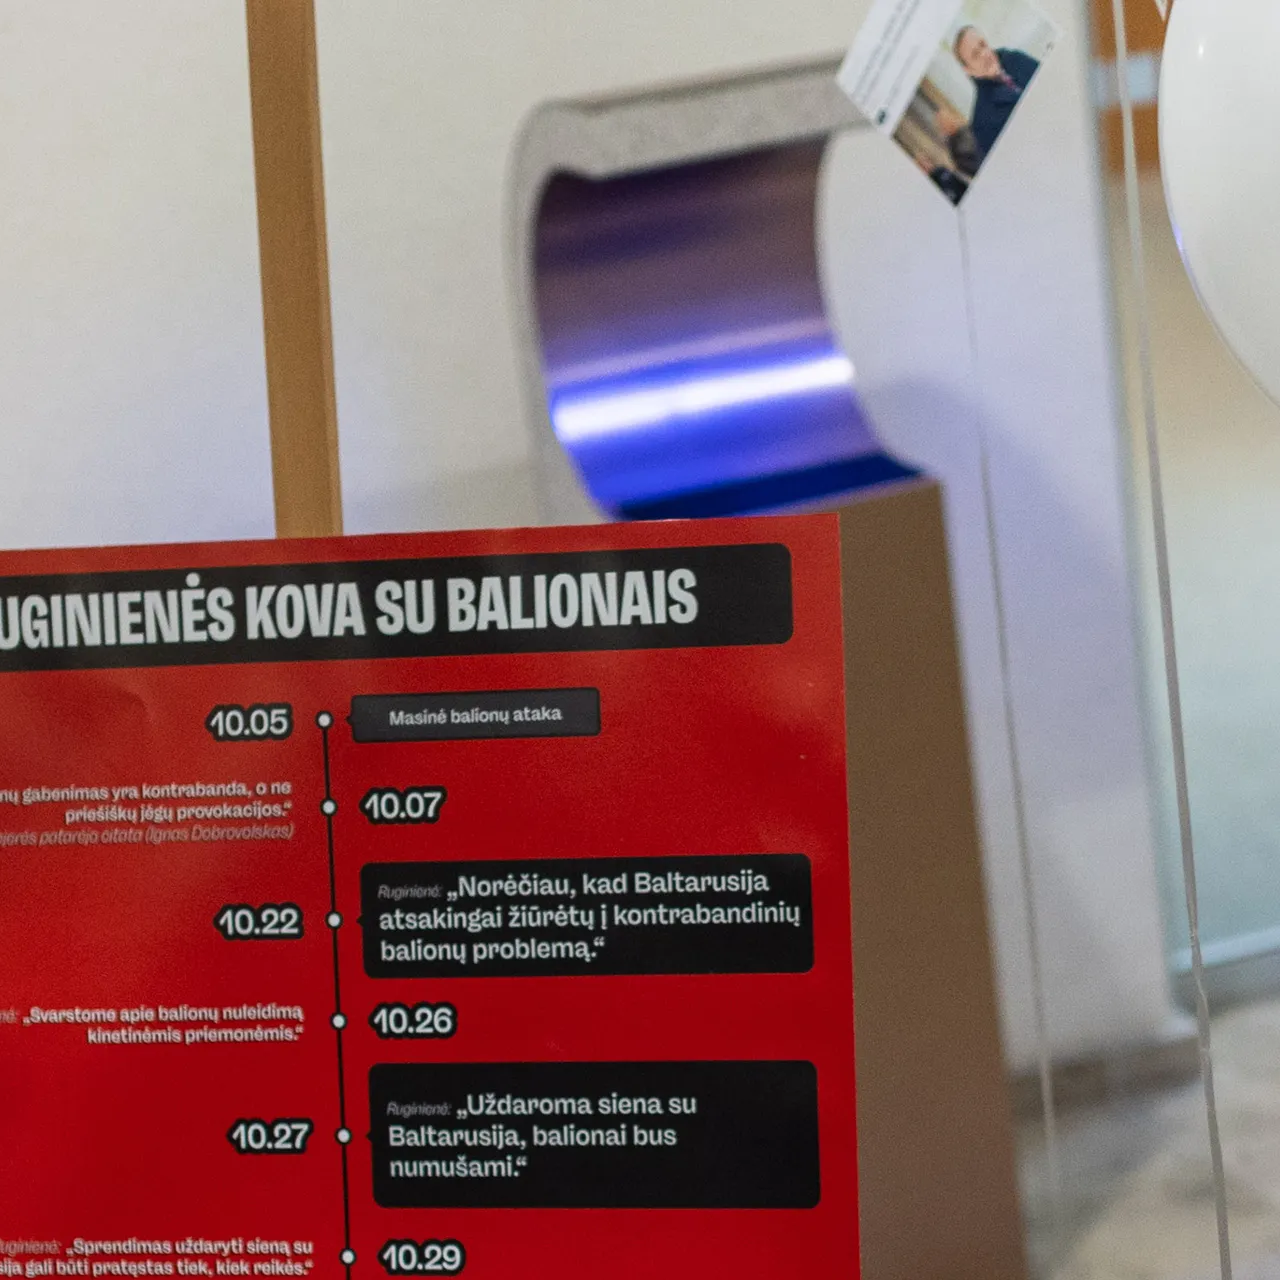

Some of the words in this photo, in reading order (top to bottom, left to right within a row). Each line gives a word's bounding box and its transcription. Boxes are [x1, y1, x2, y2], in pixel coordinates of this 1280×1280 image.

[246, 582, 365, 641] KOVA
[376, 576, 435, 636] SU
[448, 567, 698, 633] BALIONAIS
[211, 706, 289, 738] 10.05
[390, 709, 446, 726] Masinė
[451, 708, 510, 724] balionų
[513, 706, 562, 721] ataka
[23, 786, 108, 804] gabenimas
[112, 786, 139, 801] yra
[142, 781, 251, 799] kontrabanda,
[256, 783, 266, 794] o
[270, 782, 291, 794] ne
[365, 792, 443, 819] 10.07
[583, 874, 628, 895] kad
[634, 870, 769, 895] Baltarusija
[219, 908, 299, 935] 10.22
[379, 906, 502, 933] atsakingai
[509, 904, 594, 931] žiūrėtų
[601, 904, 607, 930] į
[613, 901, 799, 926] kontrabandinių
[381, 940, 466, 964] balionų
[120, 1007, 154, 1024] apie
[159, 1005, 218, 1022] balionų
[223, 1004, 304, 1022] nuleidimą
[374, 1007, 452, 1034] 10.26
[88, 1027, 181, 1045] kinetinėmis
[598, 1096, 662, 1114] siena
[669, 1096, 696, 1114] su
[232, 1124, 309, 1149] 10.27
[388, 1125, 526, 1150] Baltarusija,
[533, 1126, 626, 1146] balionai
[633, 1126, 676, 1145] bus
[175, 1238, 242, 1256] uždaryti
[293, 1241, 312, 1254] su
[383, 1244, 461, 1271] 10.29
[25, 1258, 52, 1276] gali
[56, 1258, 89, 1275] būti
[93, 1260, 173, 1278] pratęstas
[216, 1260, 248, 1275] kiek
